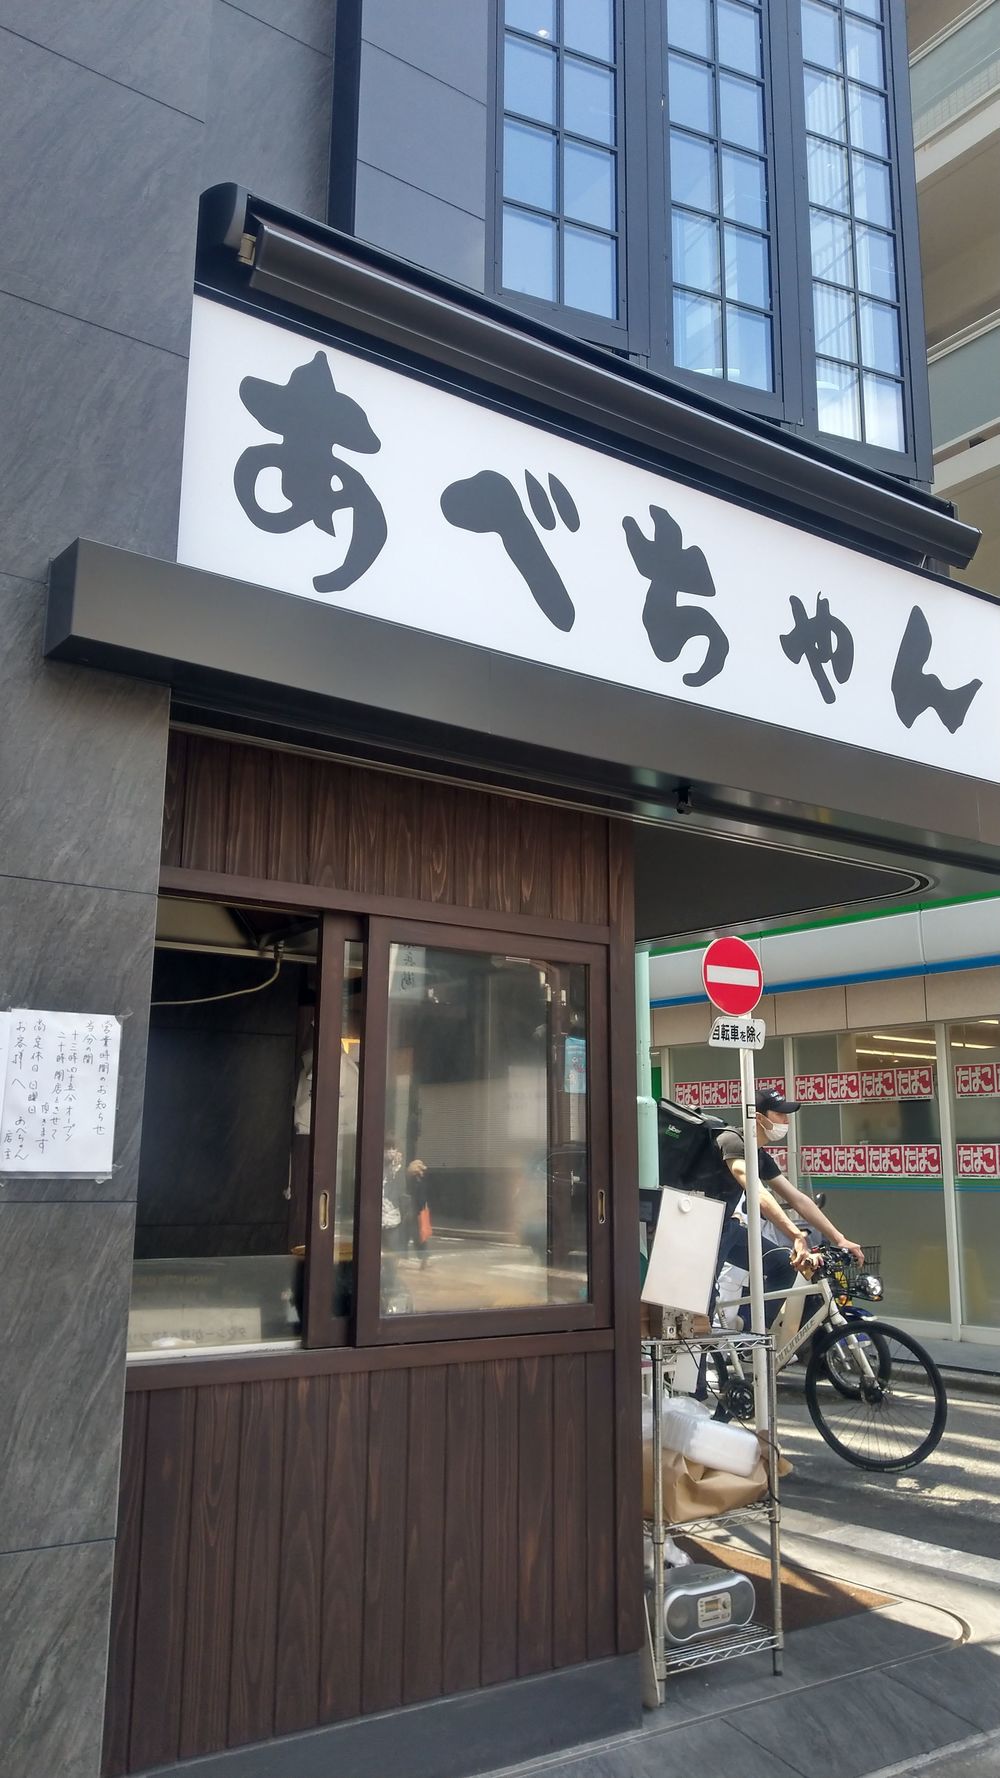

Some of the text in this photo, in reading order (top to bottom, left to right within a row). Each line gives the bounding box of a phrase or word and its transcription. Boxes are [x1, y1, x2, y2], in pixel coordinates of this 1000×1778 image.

[233, 350, 983, 734] あべちゃん
[712, 1023, 762, 1043] 自転車を除く
[796, 1076, 826, 1100] たばこ
[827, 1074, 859, 1099] たばこ
[861, 1071, 894, 1097] たばこ
[897, 1069, 932, 1095] たばこ
[957, 1066, 994, 1092] たばこ
[675, 1083, 700, 1106] たばこ
[701, 1082, 727, 1105] たばこ
[801, 1148, 832, 1172] たばこ
[834, 1147, 866, 1172] たばこ
[869, 1147, 902, 1172] たばこ
[905, 1147, 939, 1172] たばこ
[958, 1147, 997, 1172] たばこ
